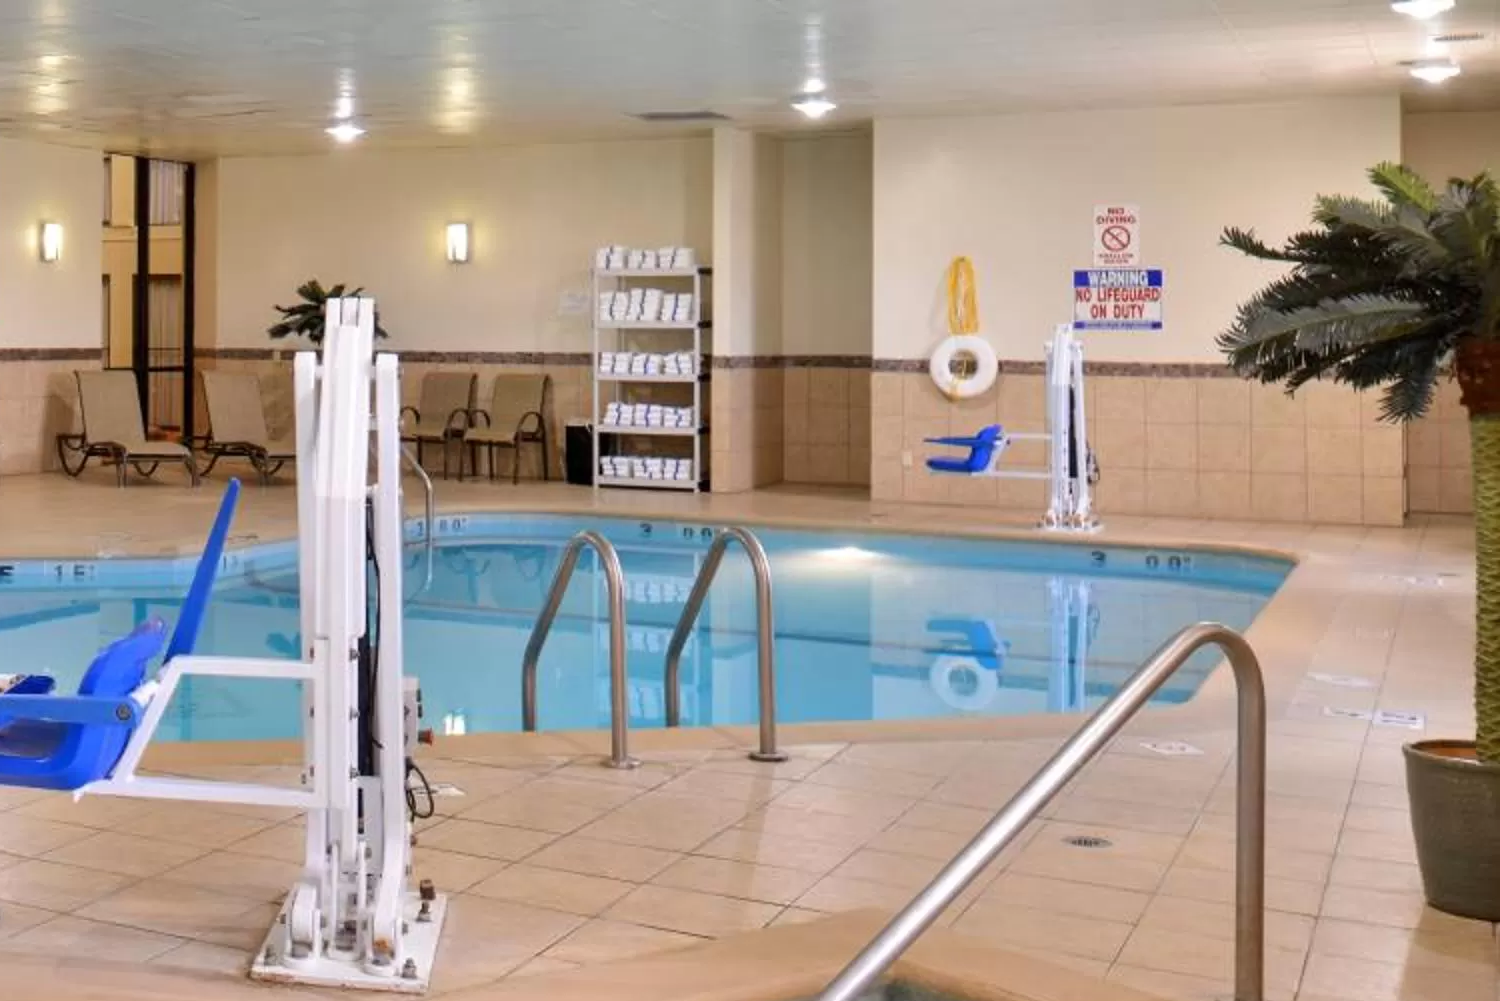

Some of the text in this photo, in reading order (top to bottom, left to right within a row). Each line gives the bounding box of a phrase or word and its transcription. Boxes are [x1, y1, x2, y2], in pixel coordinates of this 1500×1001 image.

[1088, 270, 1148, 287] WARNING
[1075, 287, 1160, 302] NO LIFEGUARD
[1091, 304, 1144, 318] ON DUTY
